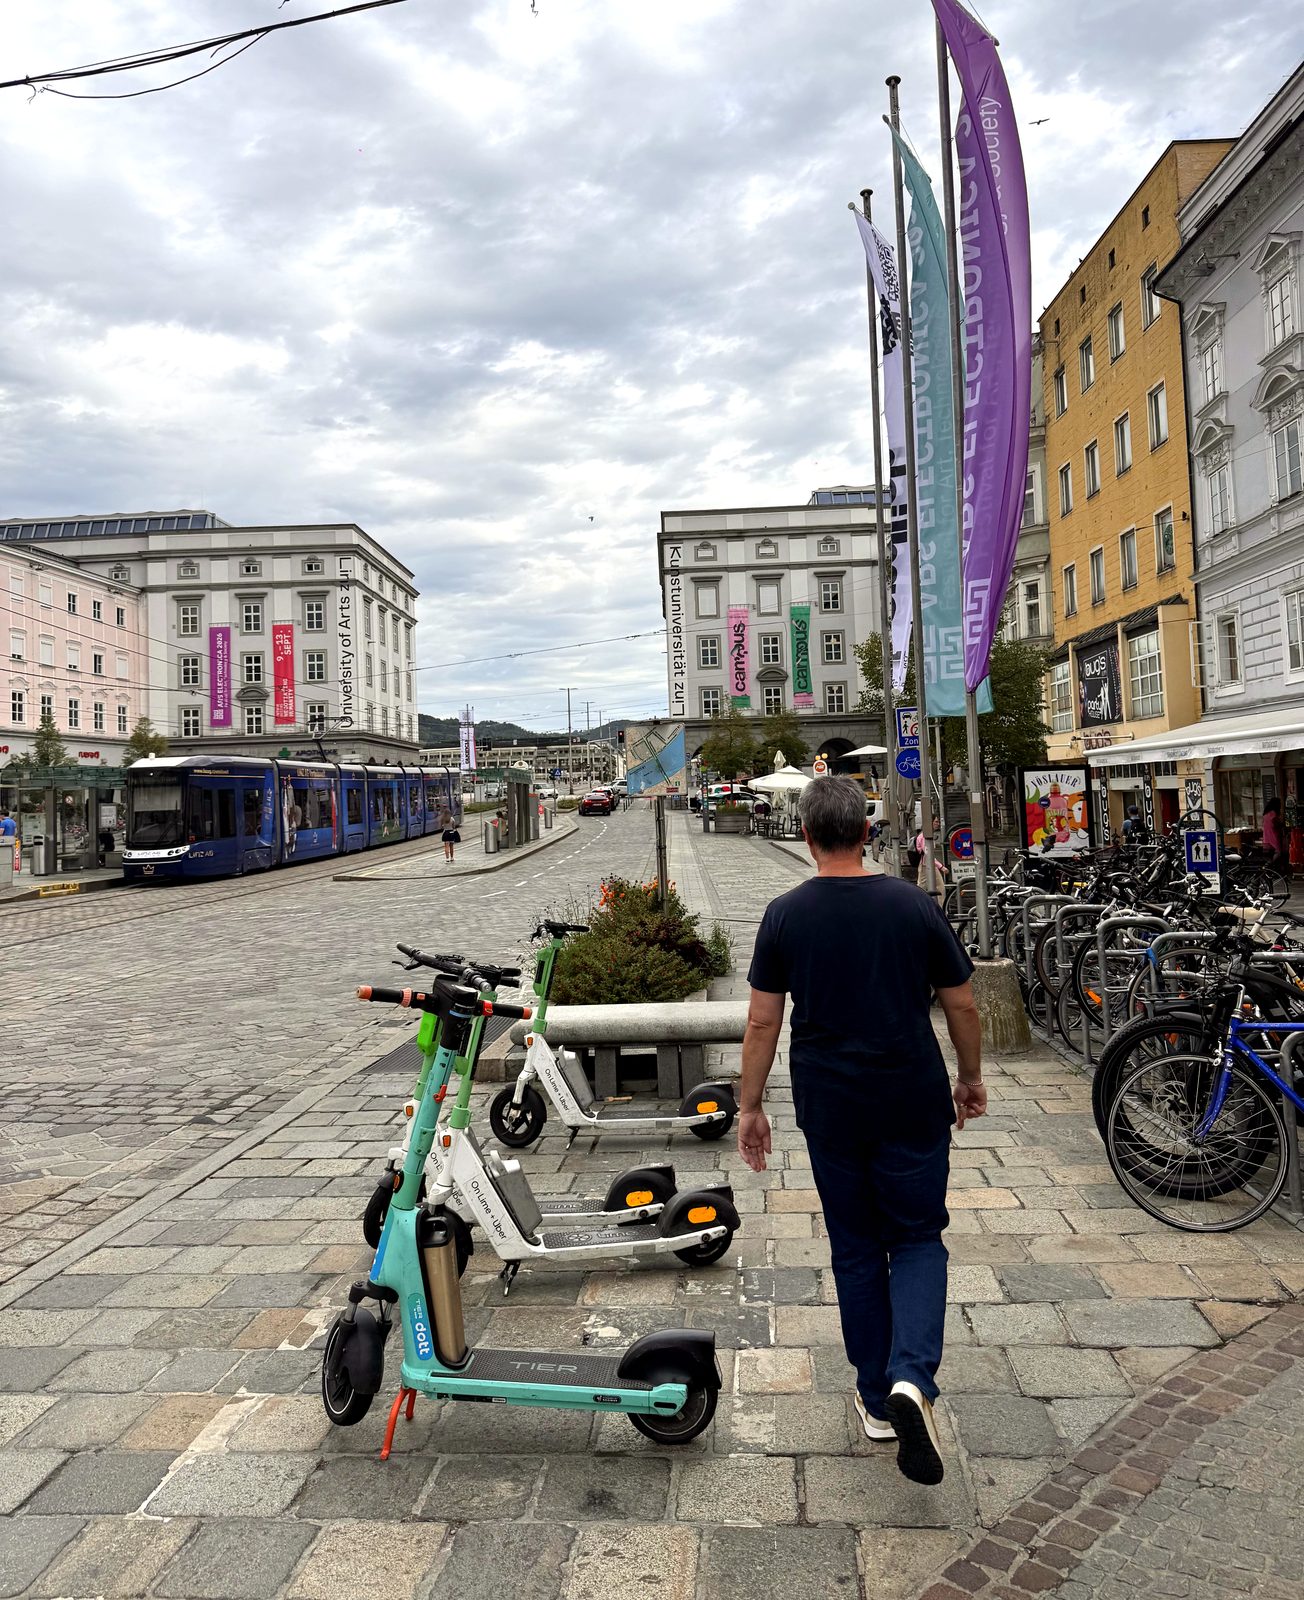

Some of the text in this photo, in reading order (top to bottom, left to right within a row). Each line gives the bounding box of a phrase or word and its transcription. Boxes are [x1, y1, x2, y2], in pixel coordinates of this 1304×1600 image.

[669, 546, 686, 677] Kunstuniversität
[283, 630, 292, 655] SEPT.
[338, 557, 354, 729] University of Arts Linz
[549, 1077, 559, 1093] Lime
[559, 1096, 570, 1112] Uber
[430, 1152, 439, 1165] On
[471, 1180, 481, 1193] On
[478, 1192, 491, 1215] Lime
[492, 1219, 507, 1240] Uber
[415, 1298, 424, 1319] TIER
[415, 1322, 430, 1355] dott
[510, 1361, 578, 1373] TIER
